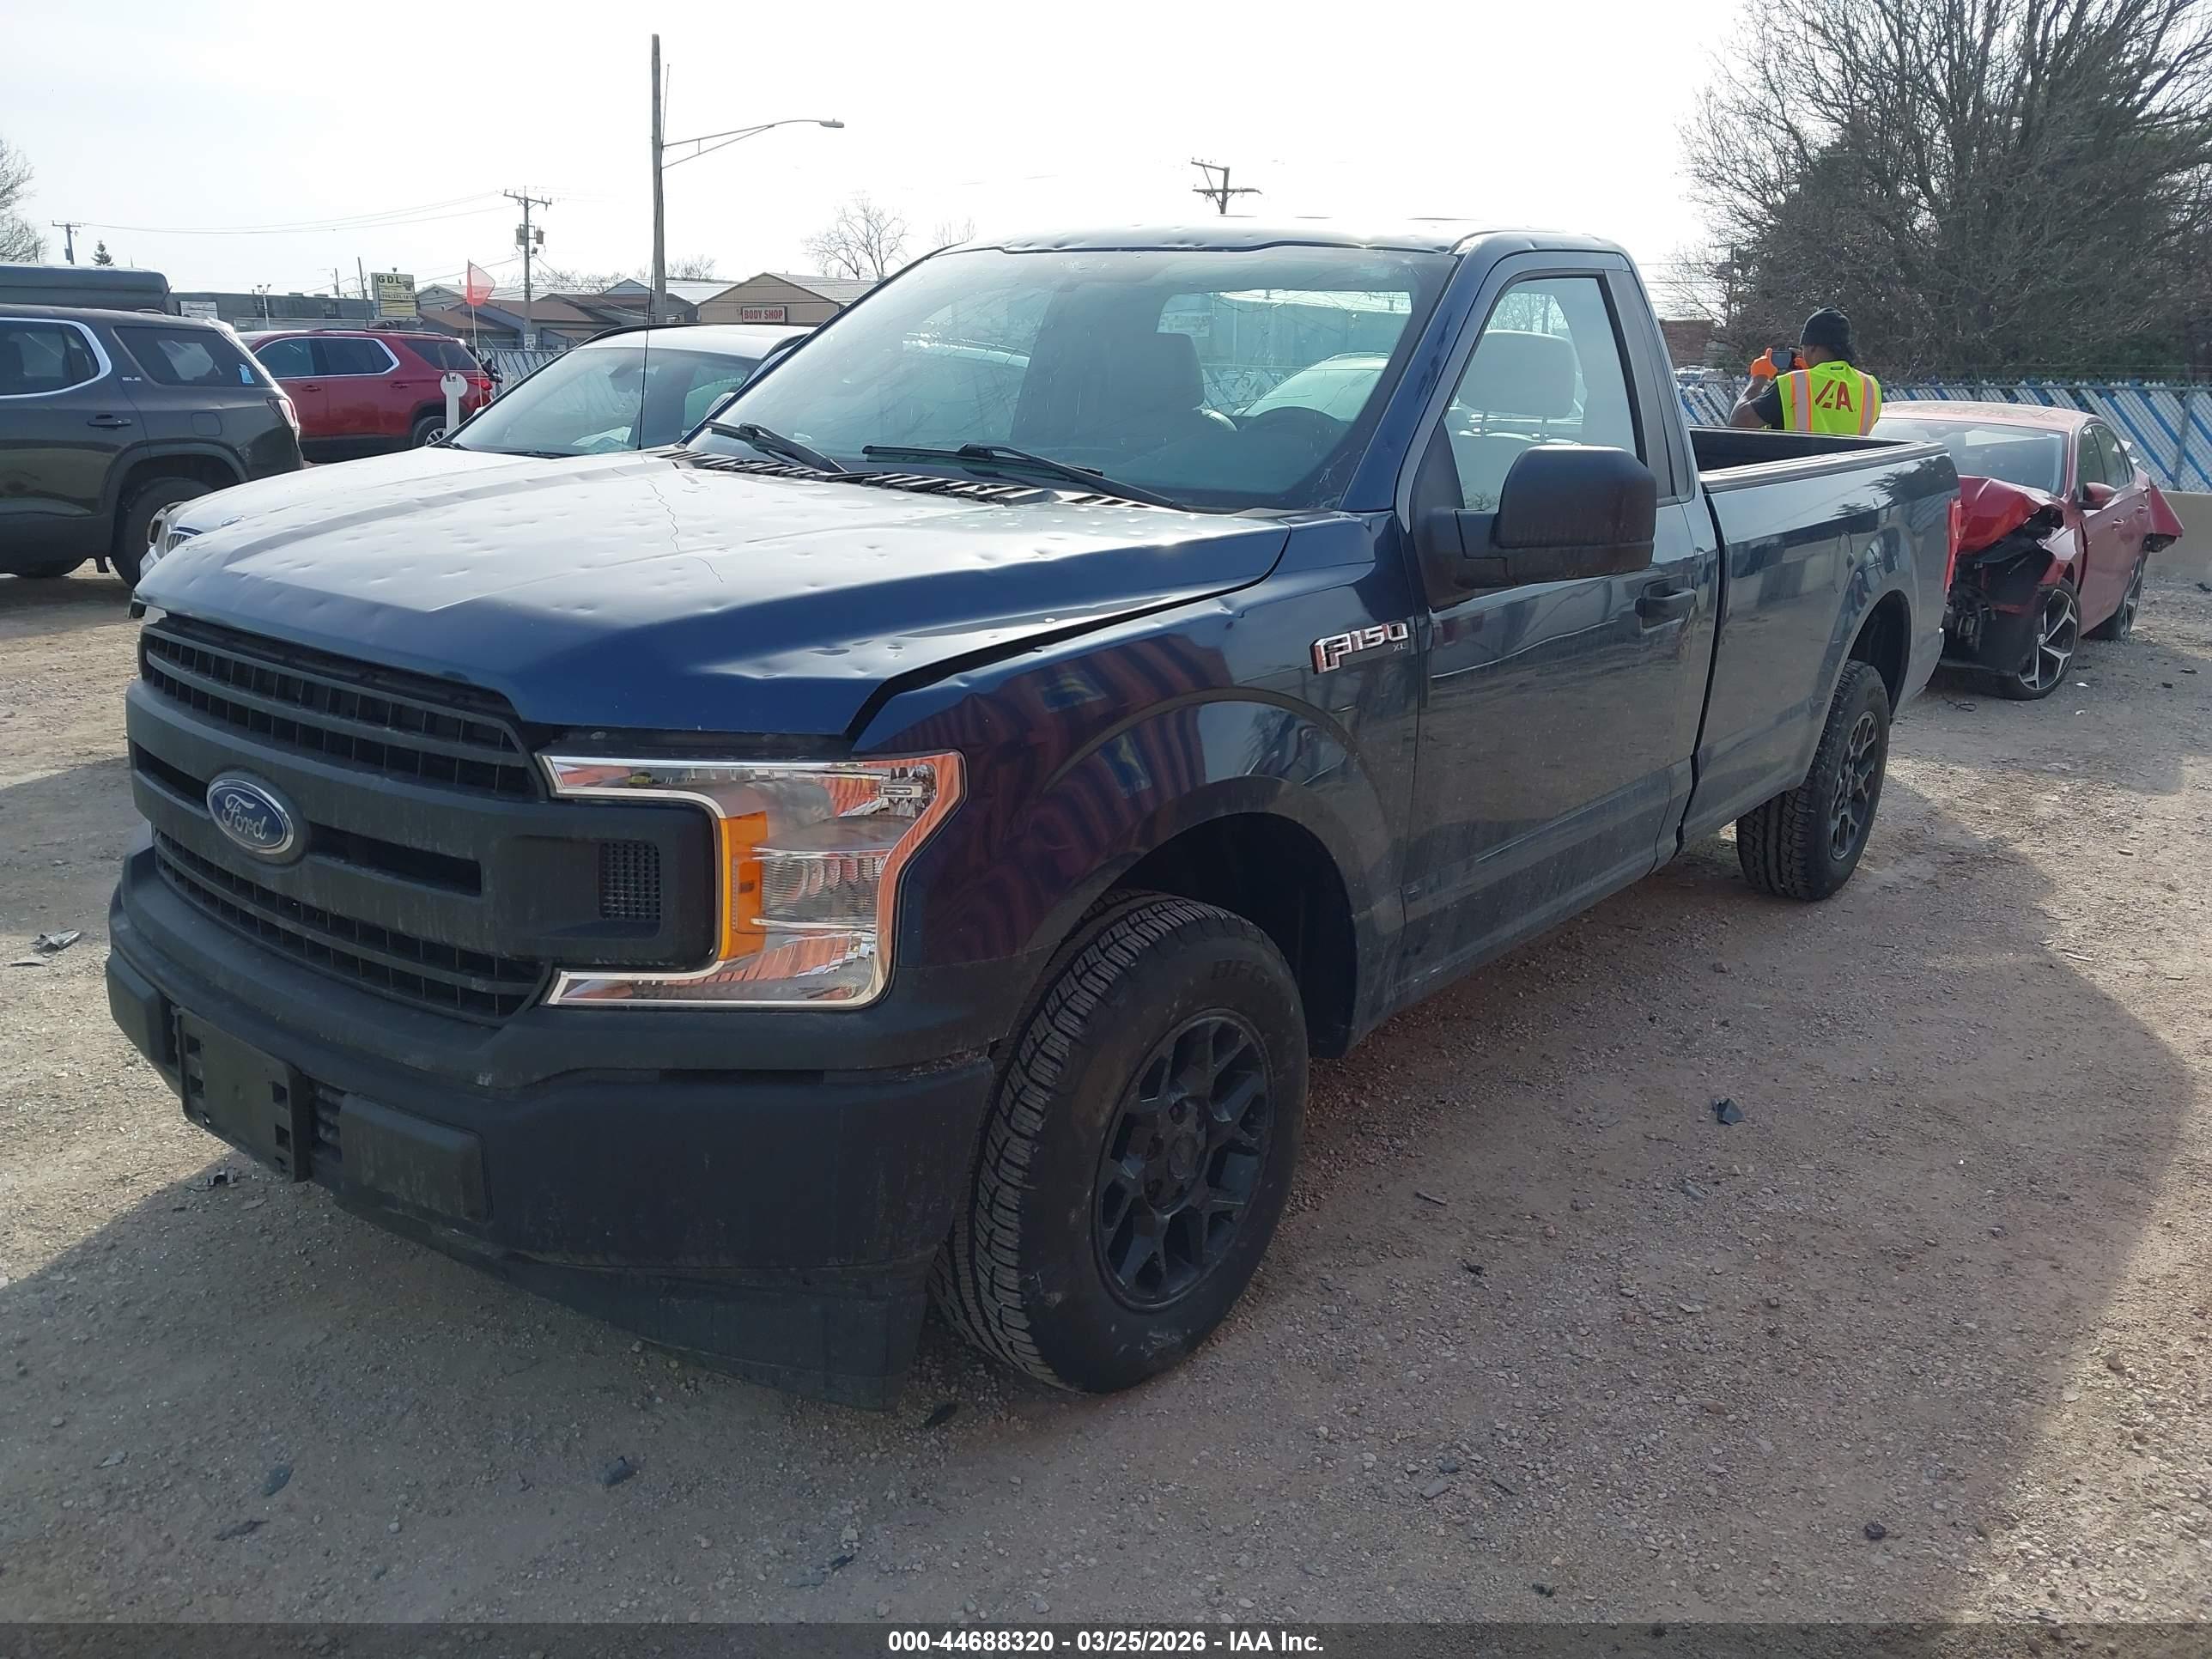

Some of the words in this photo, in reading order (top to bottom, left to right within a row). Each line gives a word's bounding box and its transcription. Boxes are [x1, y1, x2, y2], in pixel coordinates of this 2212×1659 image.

[378, 275, 402, 284] GDL
[744, 309, 763, 319] BODY
[763, 309, 783, 319] SHOP
[1392, 642, 1407, 653] XL
[222, 793, 268, 840] Ford
